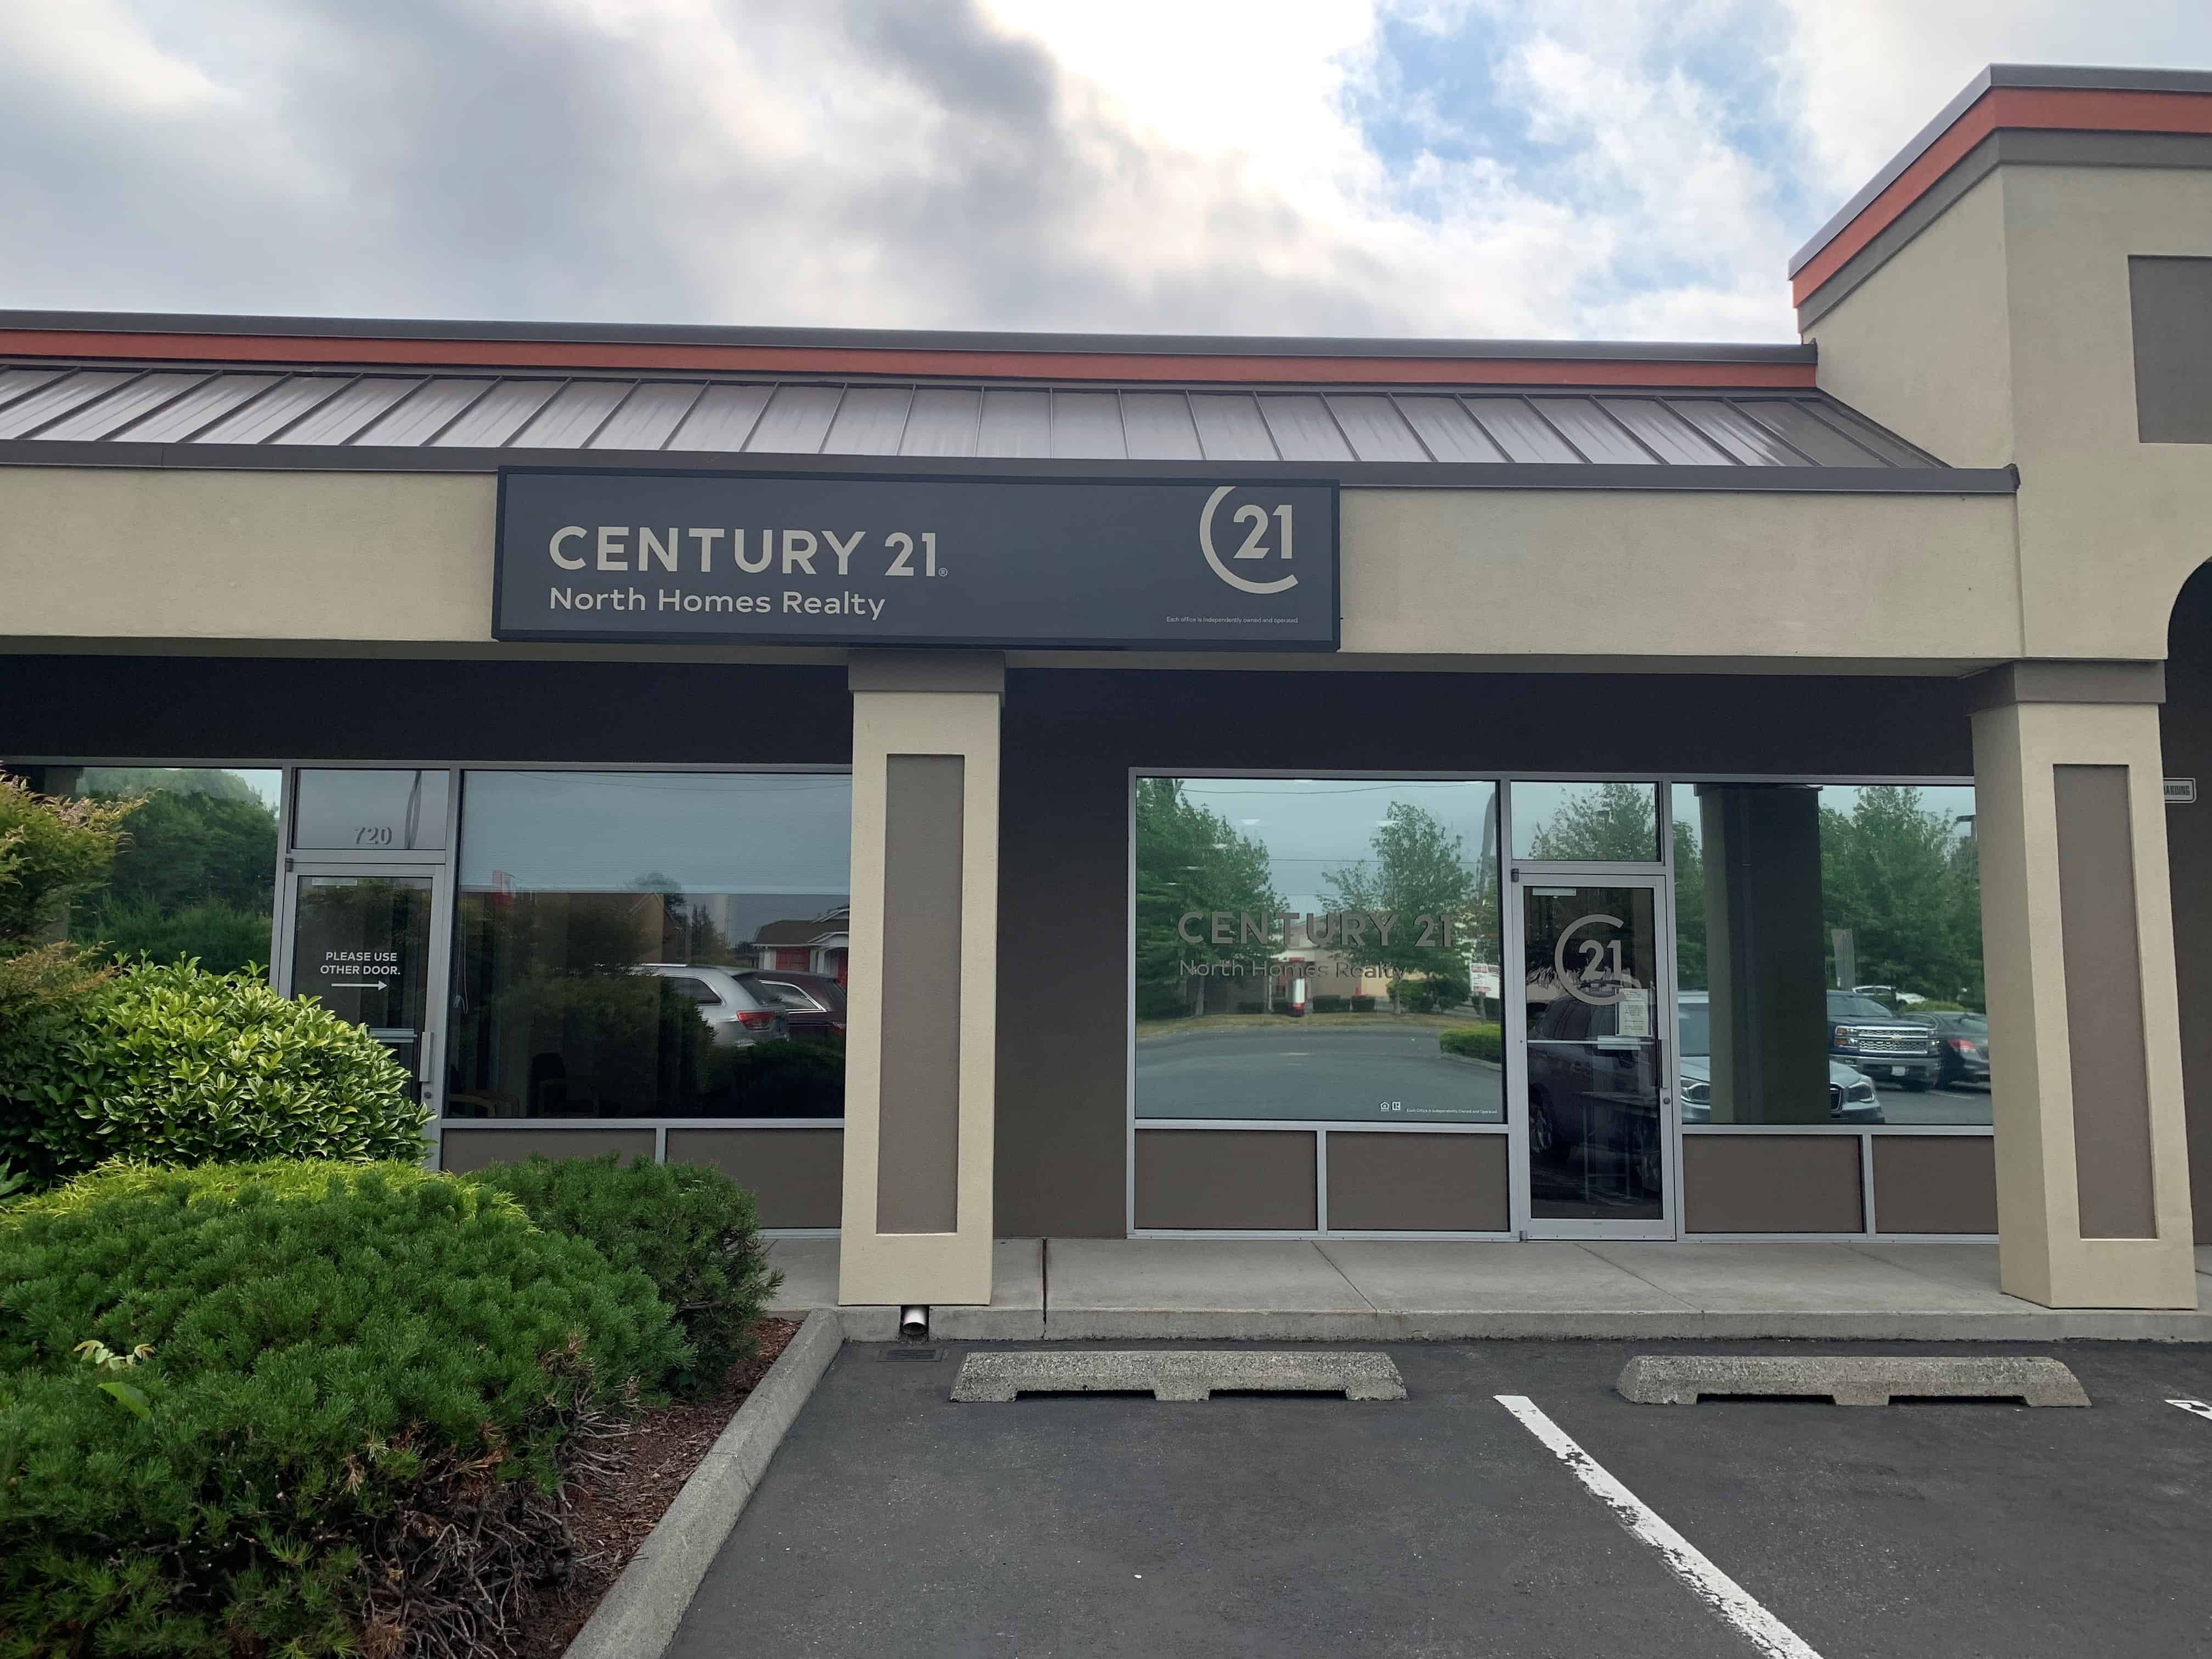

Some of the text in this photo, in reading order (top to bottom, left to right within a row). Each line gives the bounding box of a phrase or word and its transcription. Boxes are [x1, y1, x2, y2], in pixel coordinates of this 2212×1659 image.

[1233, 504, 1293, 559] 21
[549, 526, 866, 575] CENTURY
[550, 586, 886, 620] North Homes Realty
[353, 827, 392, 845] 720
[1178, 911, 1451, 947] CENTURY 21
[320, 965, 401, 975] OTHER DOOR.
[325, 952, 397, 961] PLEASE USE
[1180, 960, 1407, 980] North Homes Realty
[1579, 940, 1622, 980] 21
